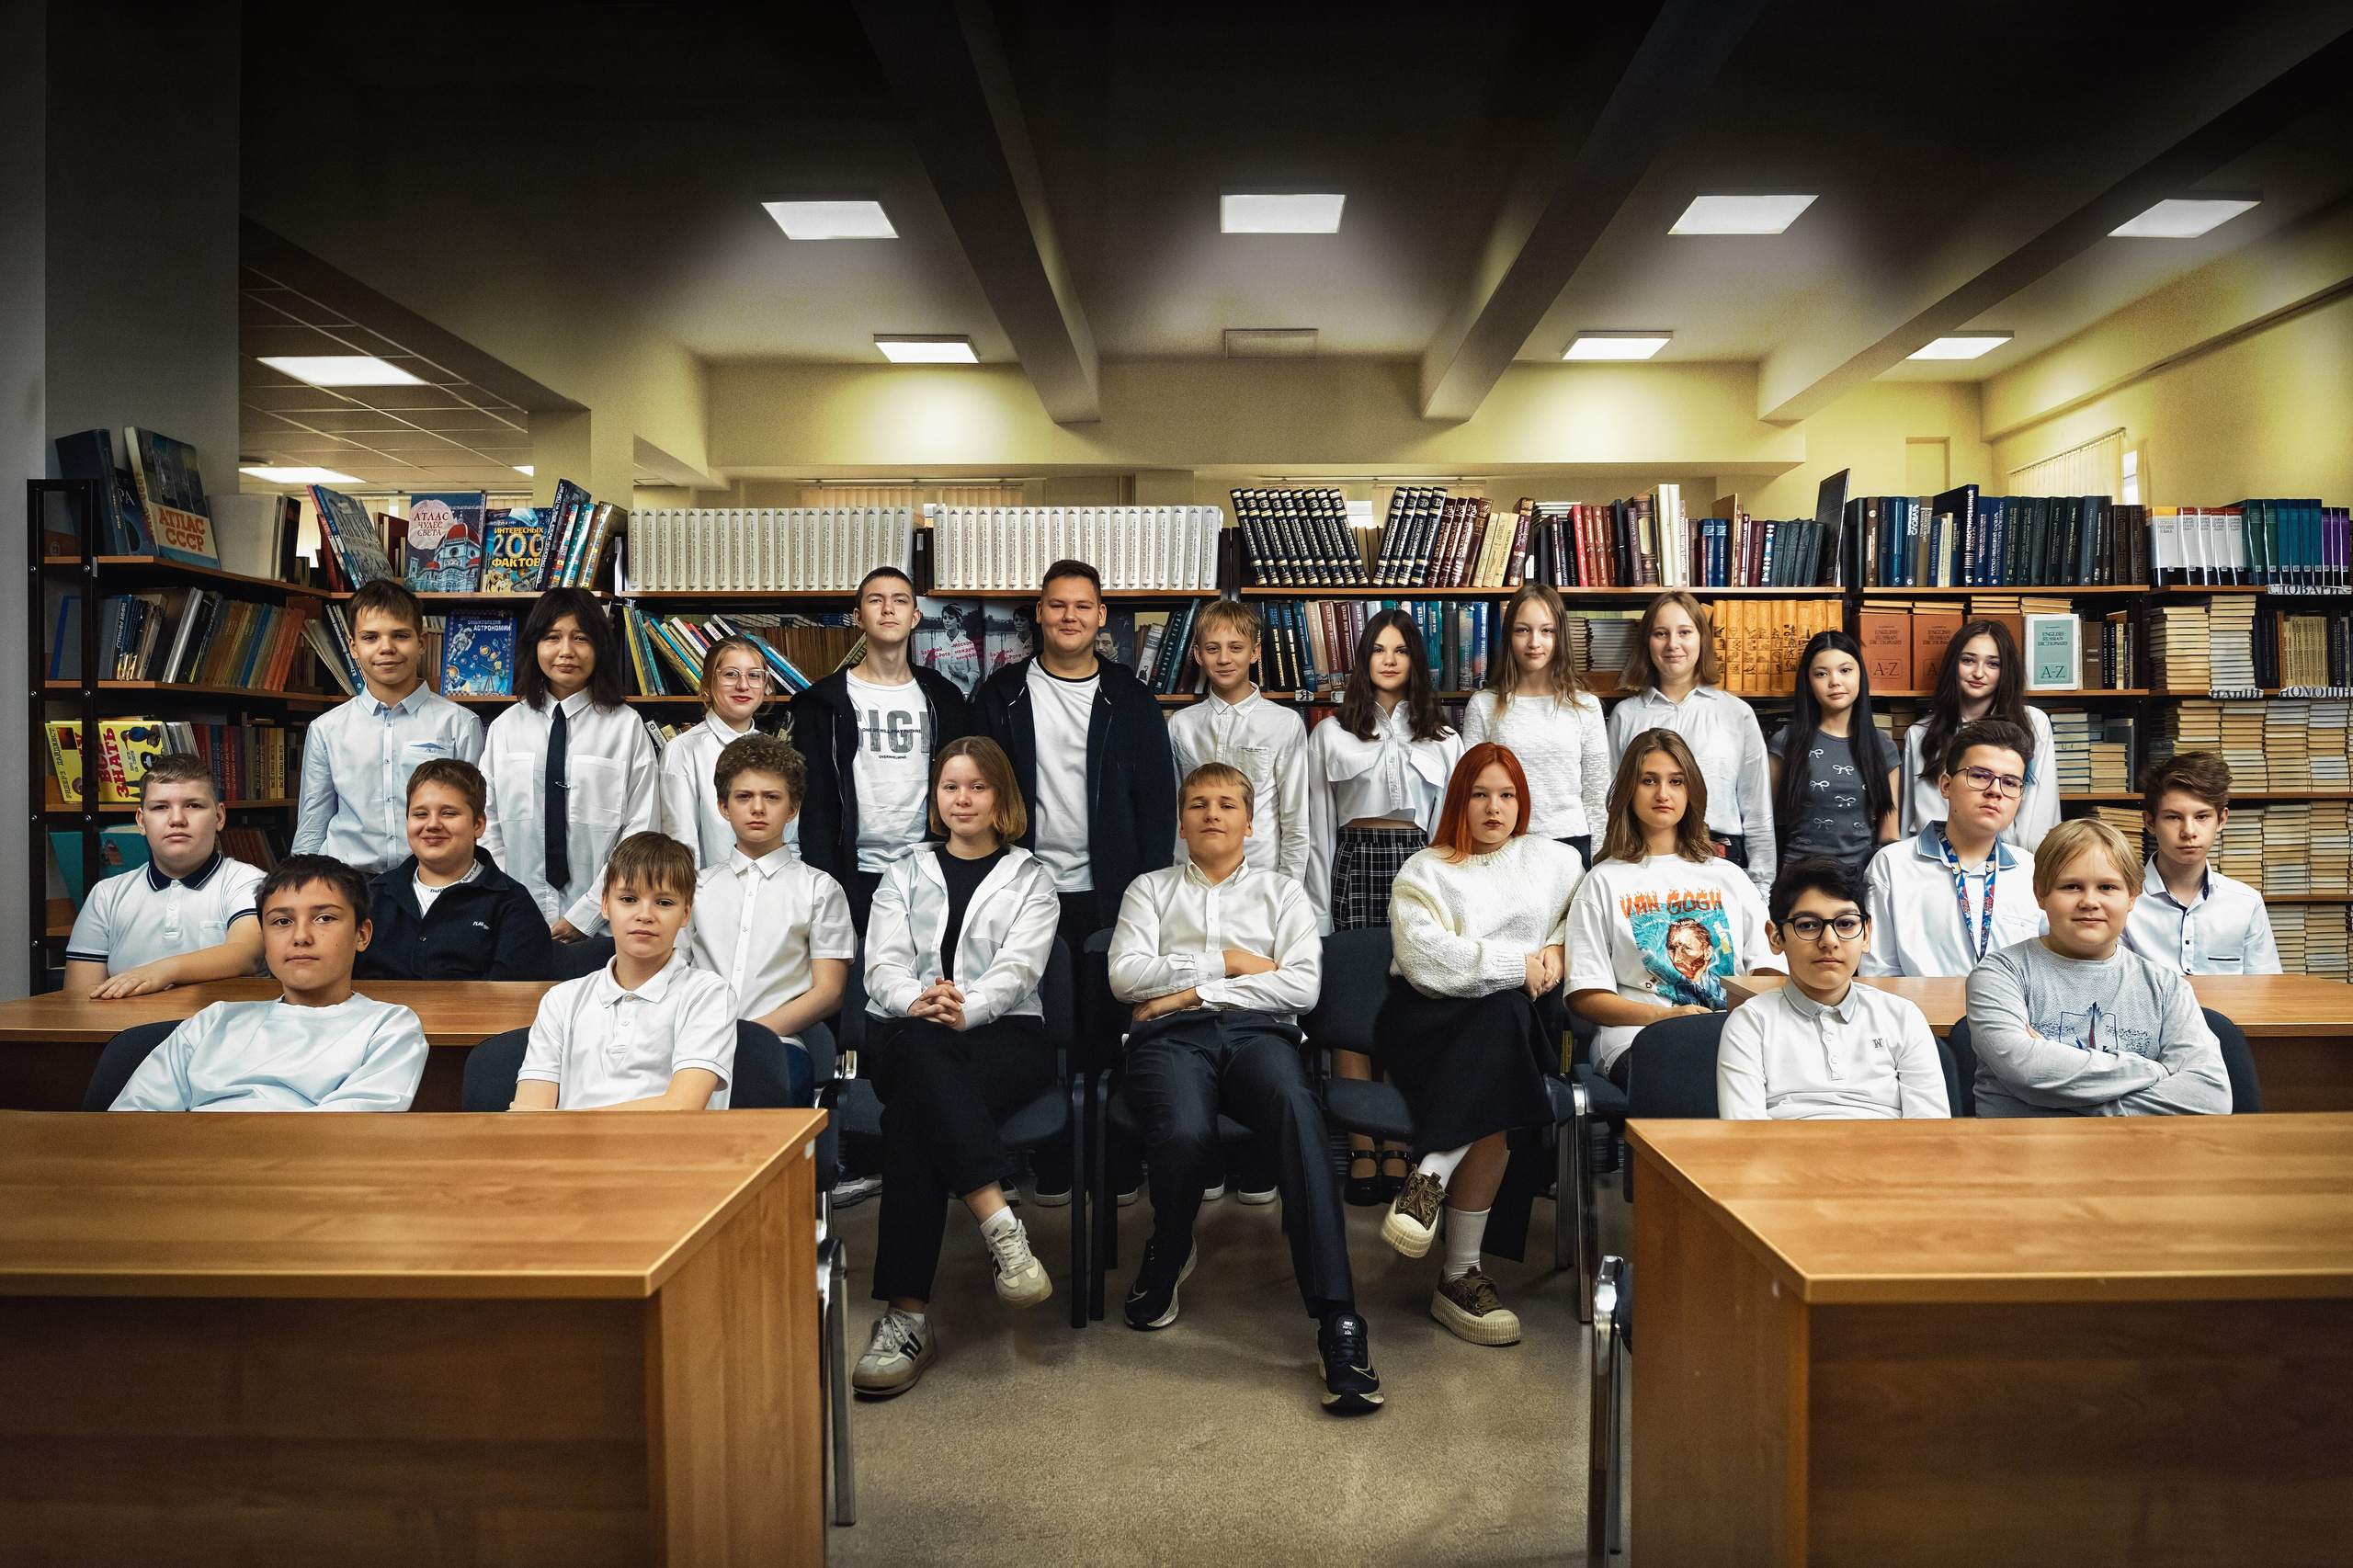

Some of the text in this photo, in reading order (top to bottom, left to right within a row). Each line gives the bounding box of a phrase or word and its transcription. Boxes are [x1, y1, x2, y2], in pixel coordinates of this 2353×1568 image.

[159, 507, 205, 535] АТЛАС
[414, 512, 449, 521] АТЛАС
[1966, 489, 1974, 551] ИЛЛЮСТРИРОВАННЫЙ
[165, 529, 204, 551] СССР
[493, 533, 544, 558] 200
[1434, 522, 1446, 557] МОСКОВСКАЯ
[1446, 522, 1458, 557] МОСКОВСКАЯ
[1457, 522, 1470, 557] МОСКОВСКАЯ
[492, 558, 541, 568] ФАКТОВ
[117, 621, 125, 648] СТРАНЫ
[1873, 662, 1899, 676] A-Z
[2041, 666, 2066, 679] A-Z
[49, 728, 72, 799] РИДЕРЗ ДАЙДЖЕСТ
[103, 728, 130, 798] ЗНАТЬ
[1620, 887, 1722, 919] VAN GOGH
